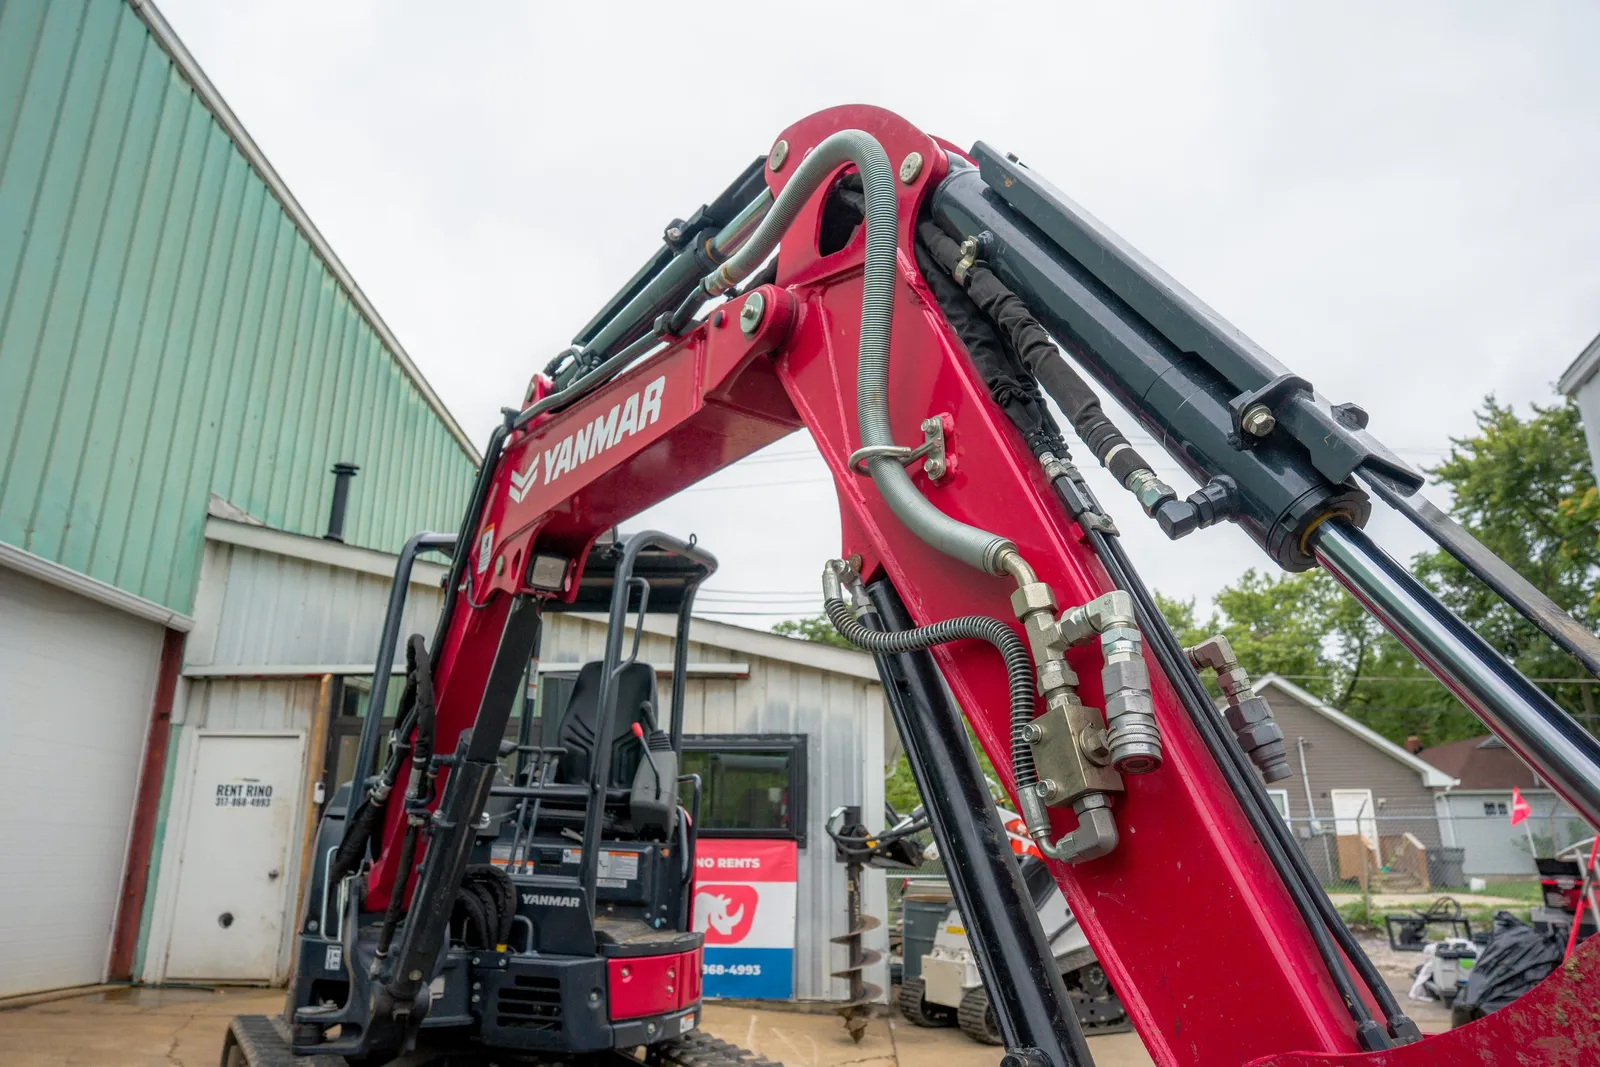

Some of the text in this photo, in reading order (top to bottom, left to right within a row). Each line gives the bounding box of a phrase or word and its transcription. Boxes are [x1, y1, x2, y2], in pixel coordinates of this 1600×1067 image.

[543, 375, 666, 486] YANMAR
[216, 784, 273, 798] RENT RINO
[717, 857, 761, 869] RENTS
[521, 893, 581, 908] YANMAR
